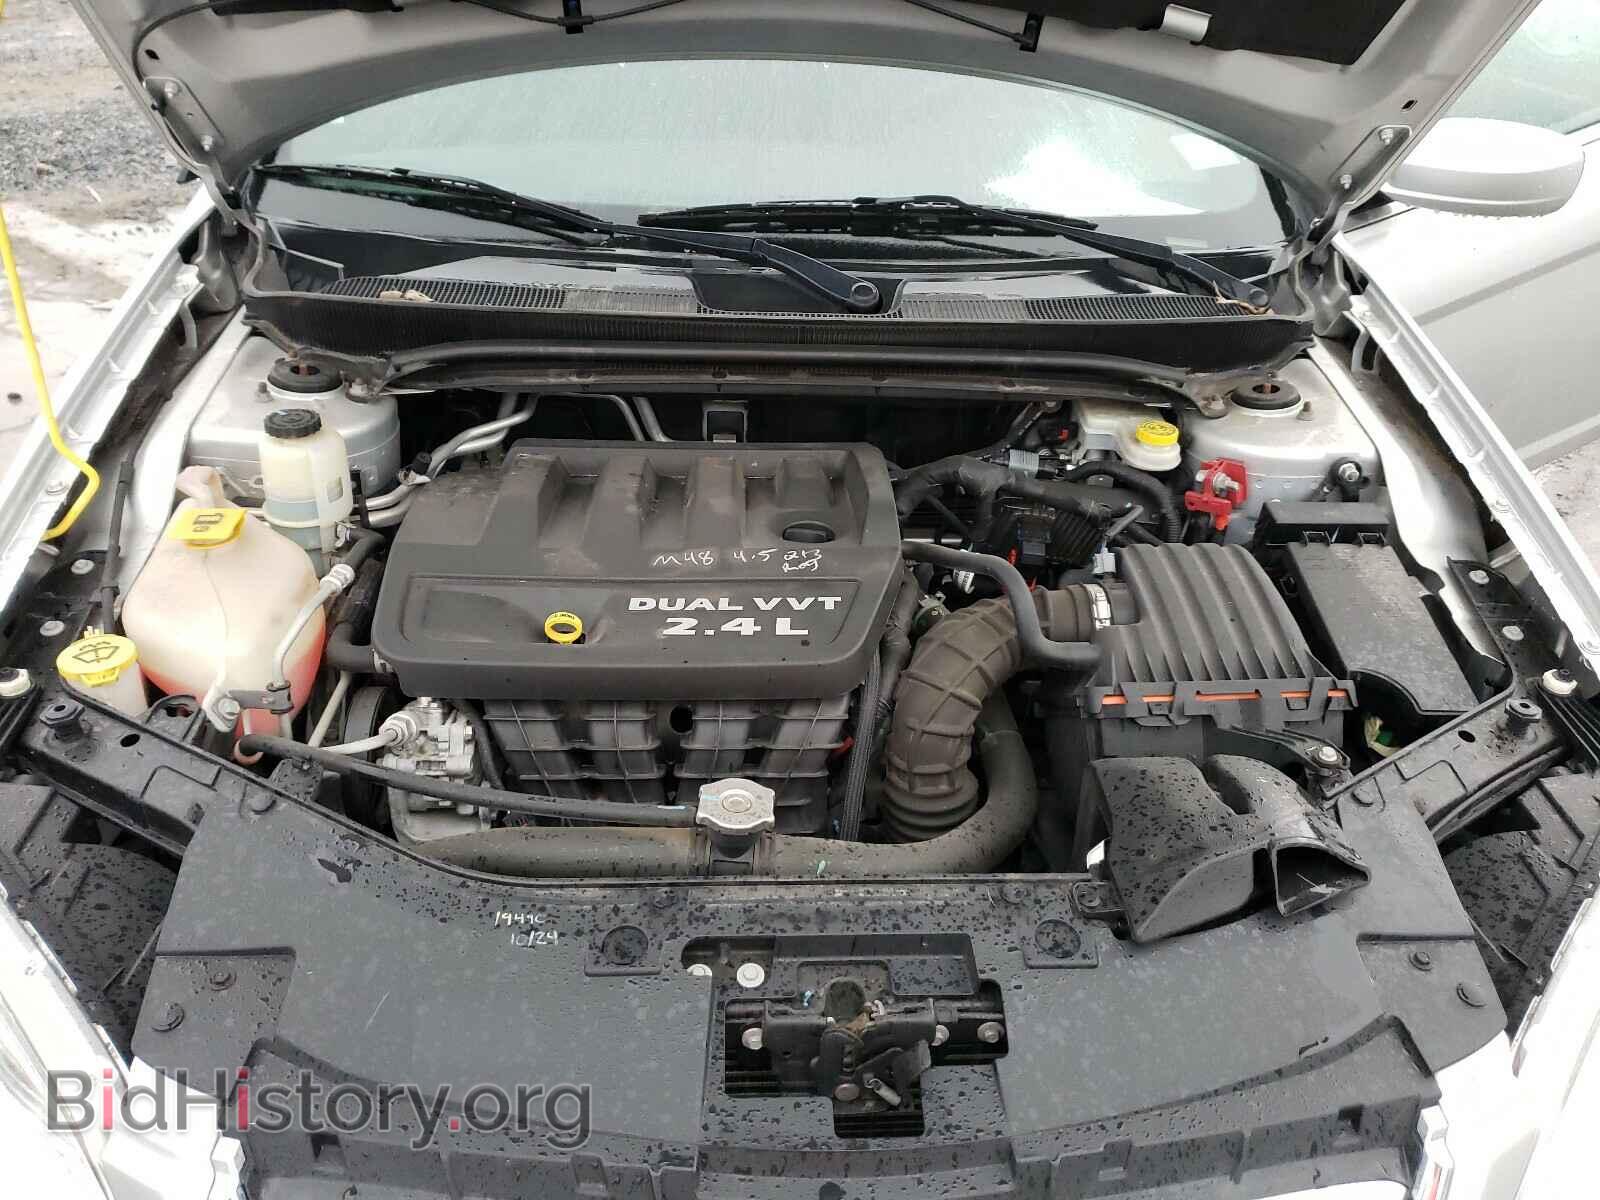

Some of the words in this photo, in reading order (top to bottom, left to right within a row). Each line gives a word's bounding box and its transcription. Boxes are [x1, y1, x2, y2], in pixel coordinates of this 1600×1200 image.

[628, 597, 743, 611] DUAL
[752, 596, 842, 611] VVT
[662, 617, 809, 636] 2.4L
